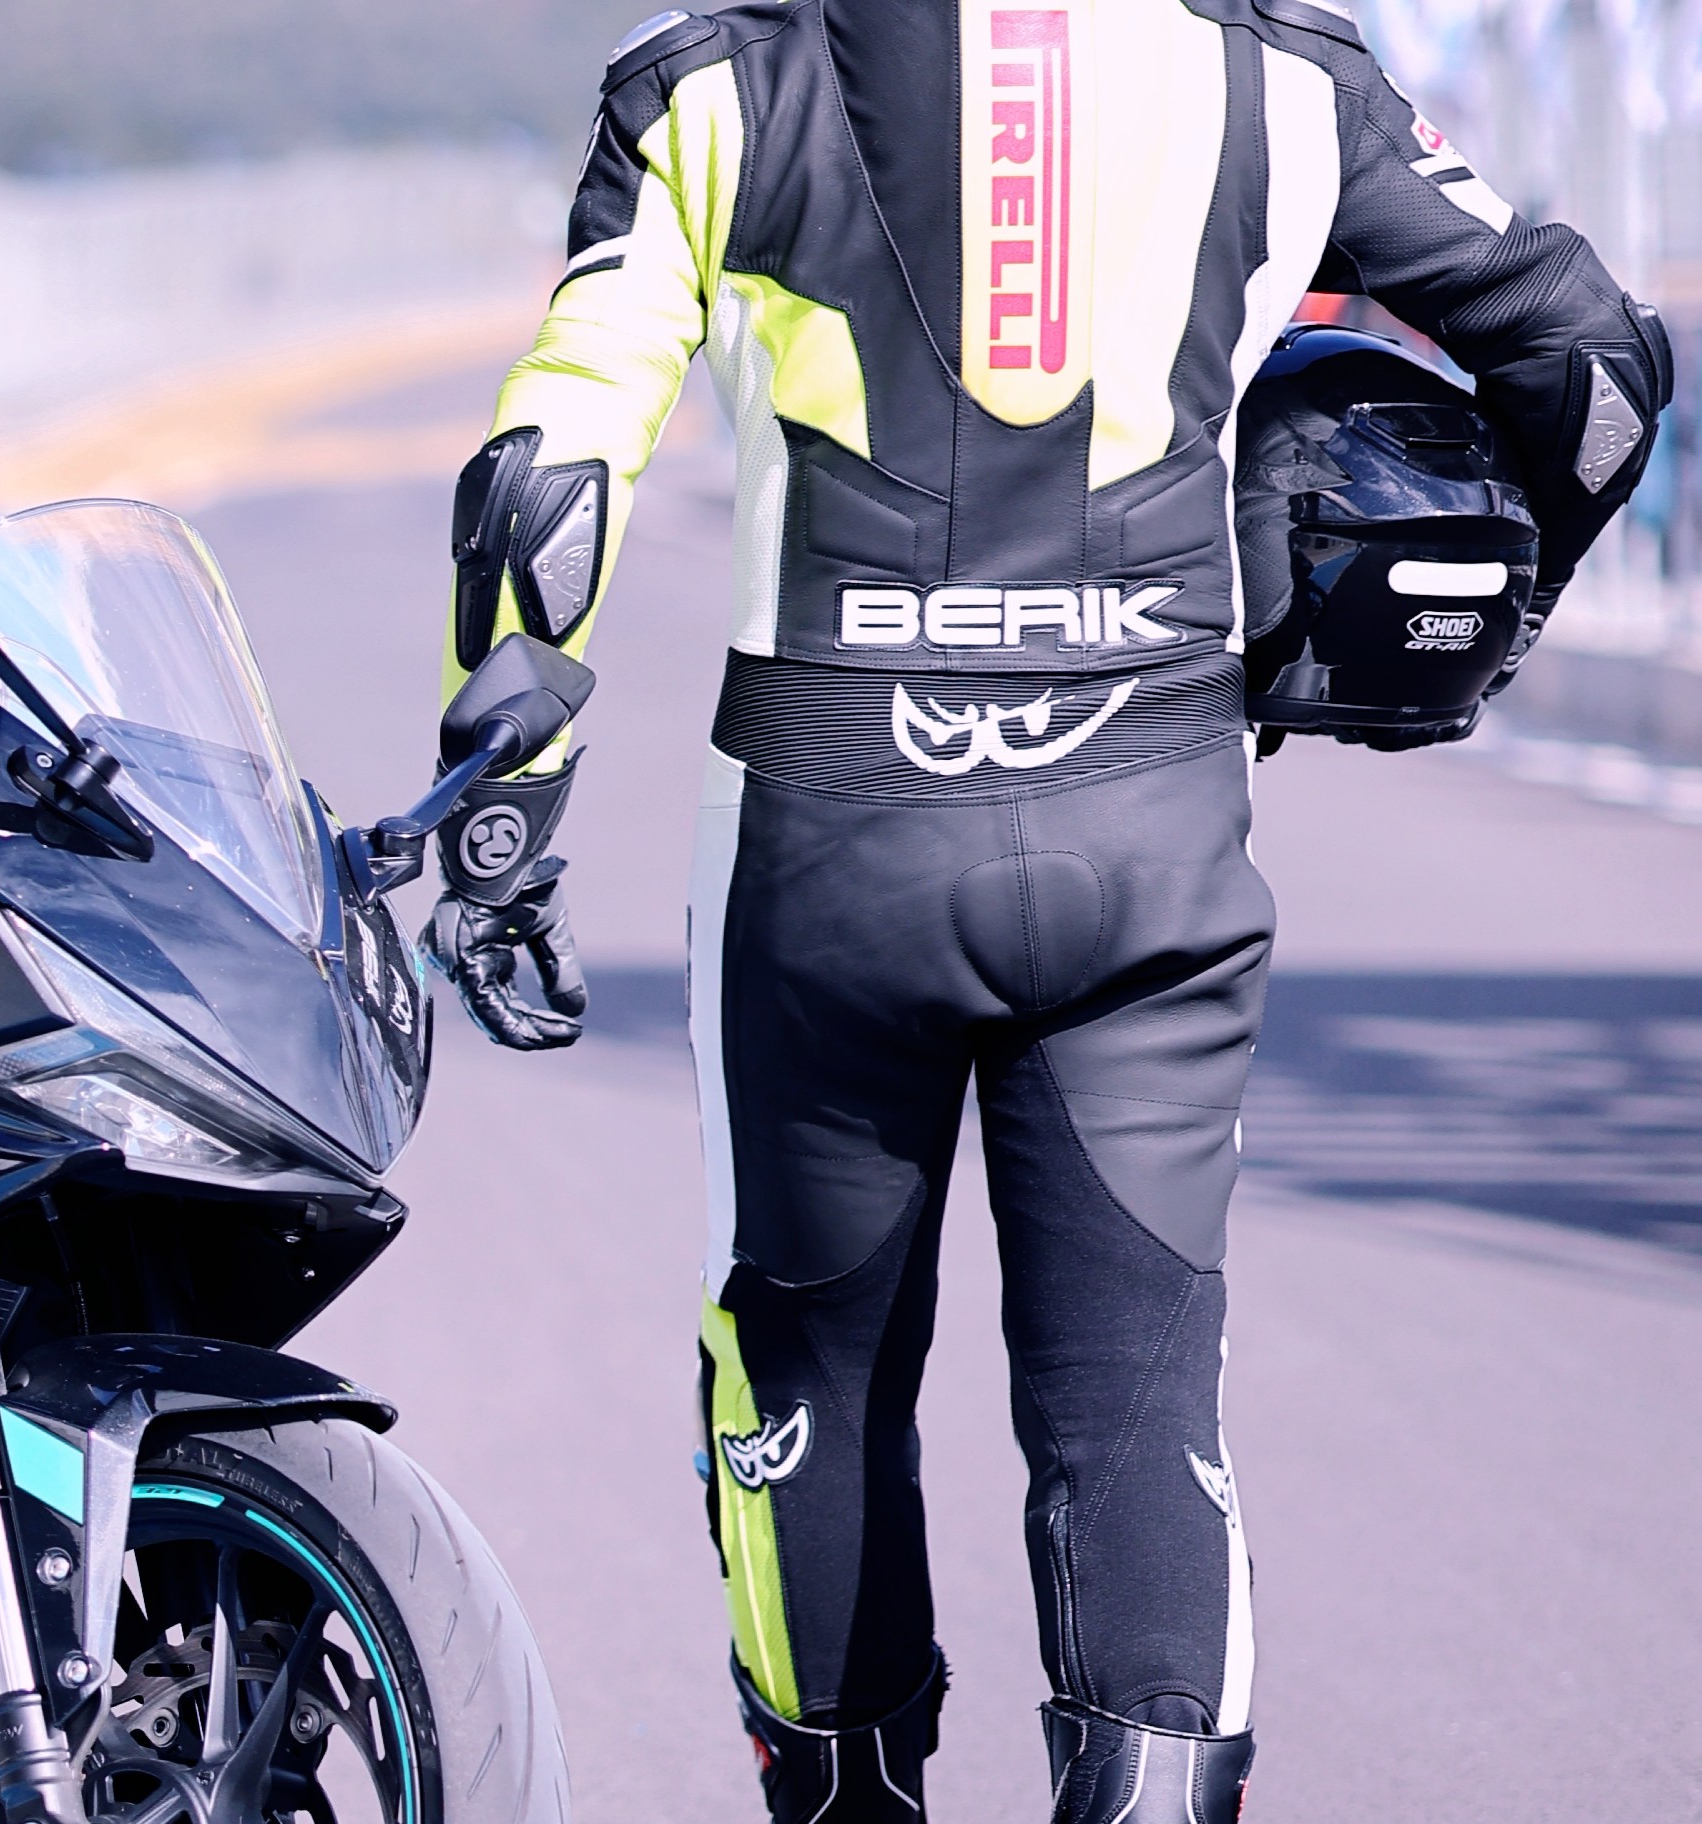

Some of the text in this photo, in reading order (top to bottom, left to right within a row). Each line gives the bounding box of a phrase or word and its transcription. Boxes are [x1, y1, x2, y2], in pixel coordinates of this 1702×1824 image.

[989, 9, 1071, 374] PIRELLI
[841, 586, 1182, 647] BERIK
[1419, 616, 1476, 638] SHOEI
